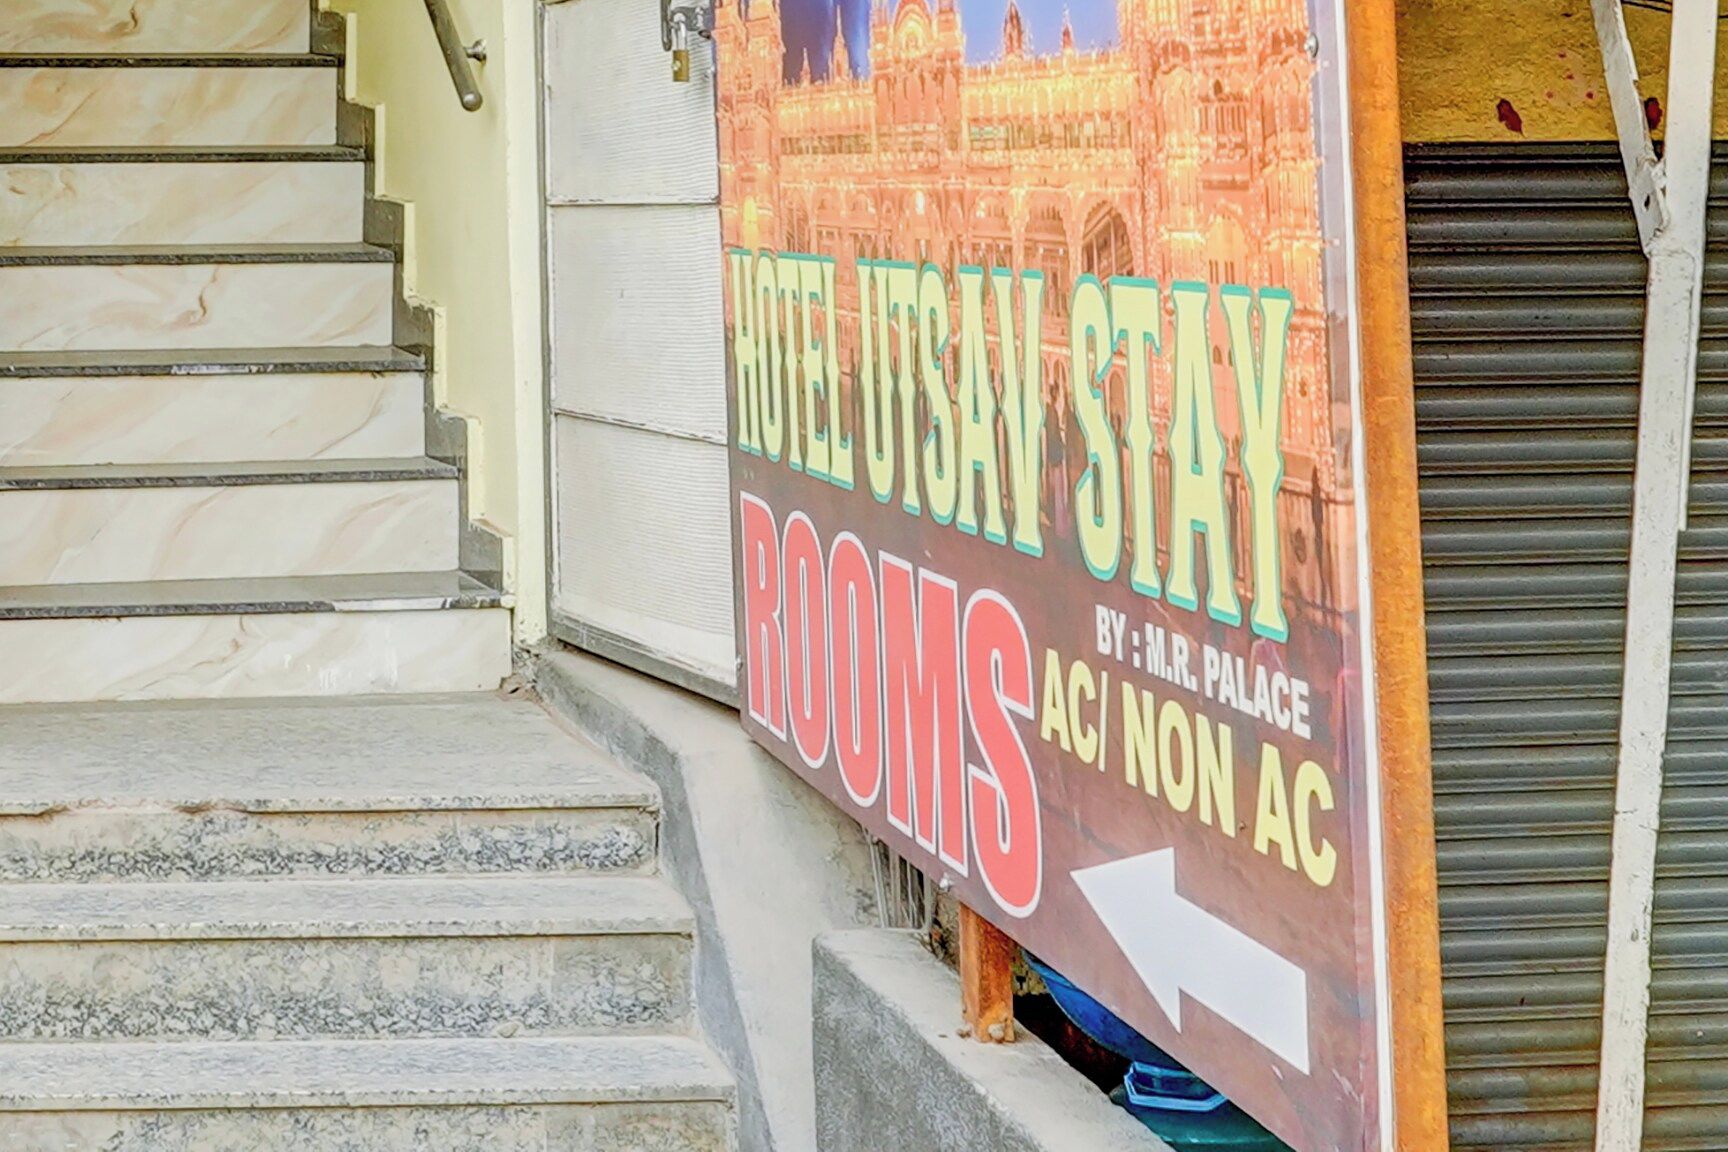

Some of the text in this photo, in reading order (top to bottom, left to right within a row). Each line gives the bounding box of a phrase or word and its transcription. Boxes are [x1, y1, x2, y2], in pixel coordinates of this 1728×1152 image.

[729, 249, 1293, 644] HOTEL UTSAV STAY
[739, 490, 1042, 919] ROOMS
[1041, 648, 1337, 887] AC/ NON AC
[1095, 604, 1126, 662] BY
[1145, 622, 1198, 692] M.R.
[1203, 644, 1311, 740] PALACE
